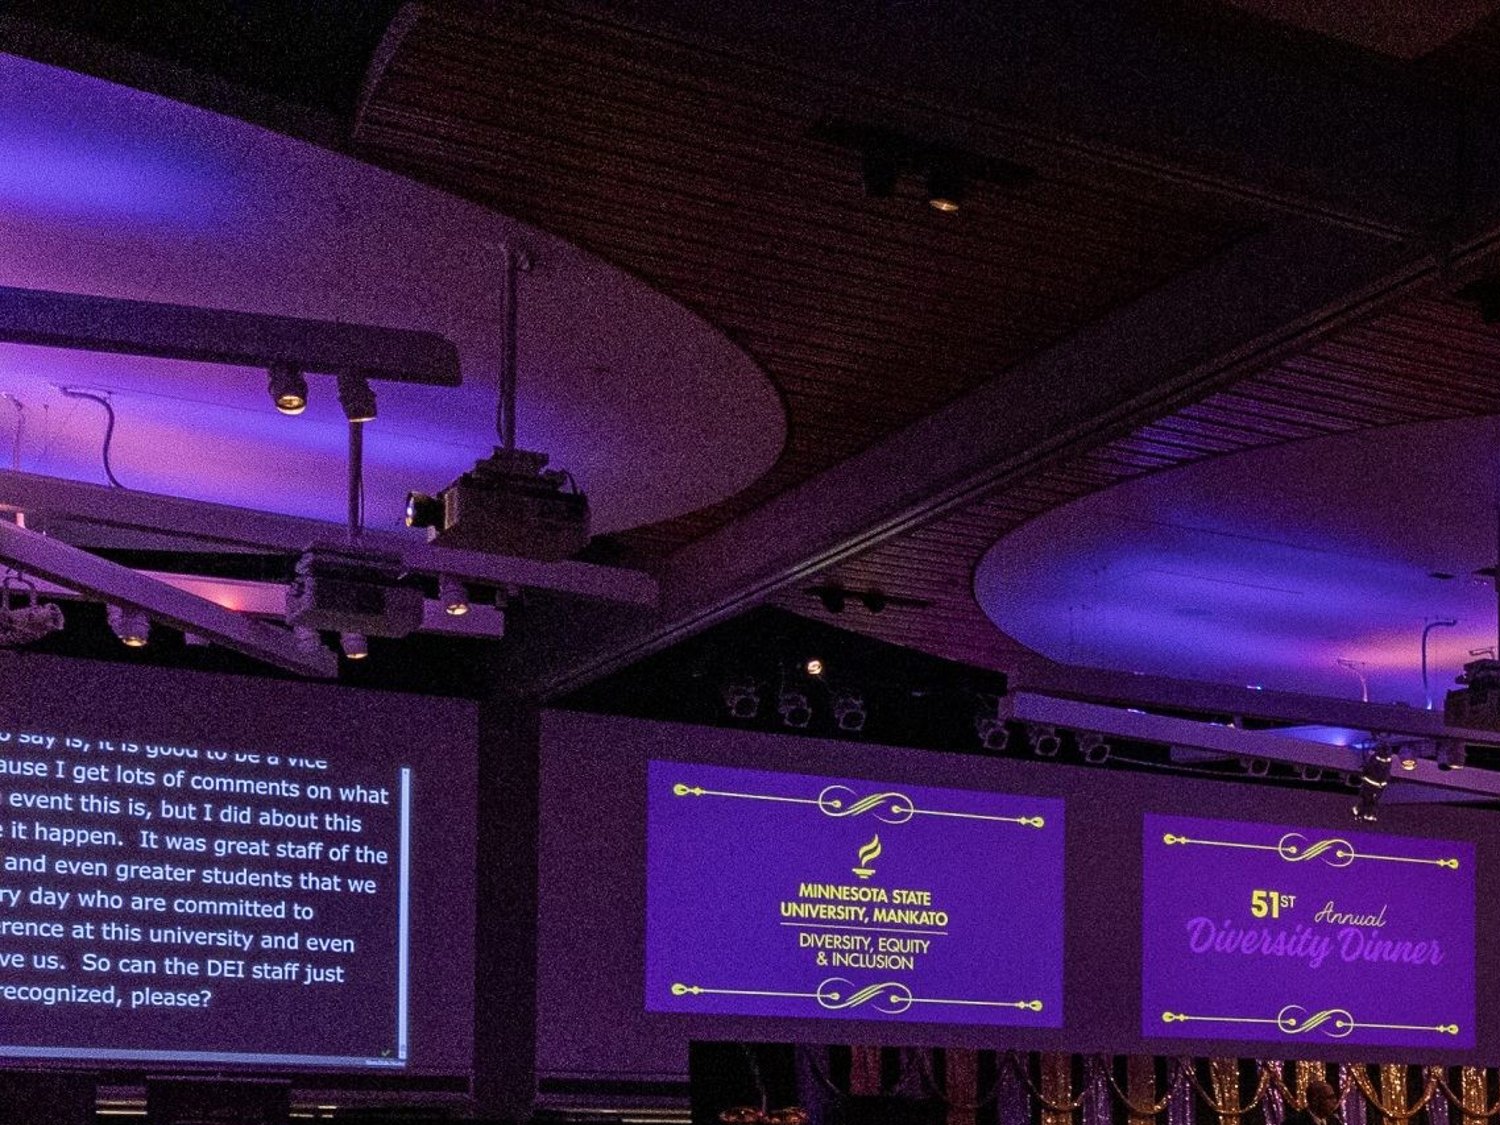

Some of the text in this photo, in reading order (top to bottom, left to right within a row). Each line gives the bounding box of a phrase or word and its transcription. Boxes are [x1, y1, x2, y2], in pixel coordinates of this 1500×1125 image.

[56, 761, 64, 778] I
[73, 765, 109, 783] get
[117, 765, 155, 785] lots
[163, 770, 185, 787] of
[191, 776, 300, 797] comments
[307, 786, 331, 799] on
[340, 785, 388, 804] what
[10, 793, 361, 832] event this is, but I did about this
[12, 821, 387, 864] it happen. It was great staff of the
[5, 855, 376, 893] and even greater students that we
[30, 886, 70, 909] day
[78, 890, 122, 908] who
[132, 896, 166, 911] are
[174, 899, 285, 918] committed
[294, 904, 313, 920] to
[799, 883, 931, 906] MINNESOTA STATE
[1251, 889, 1388, 927] 51ST Annual
[781, 902, 948, 926] UNIVERSITY, MANKATO
[72, 923, 94, 939] at
[102, 922, 141, 941] this
[150, 927, 253, 950] university
[261, 933, 298, 949] and
[307, 938, 354, 952] even
[800, 933, 930, 953] DIVERSITY, EQUITY
[1186, 915, 1444, 969] Diversity Dinner
[34, 956, 65, 969] us.
[83, 954, 110, 971] So
[119, 959, 156, 973] can
[164, 958, 199, 975] the
[208, 960, 244, 978] DEI
[252, 963, 299, 980] staff
[304, 964, 344, 984] just
[816, 951, 913, 970] & INCLUSION
[0, 985, 211, 1008] ecognized, please?
